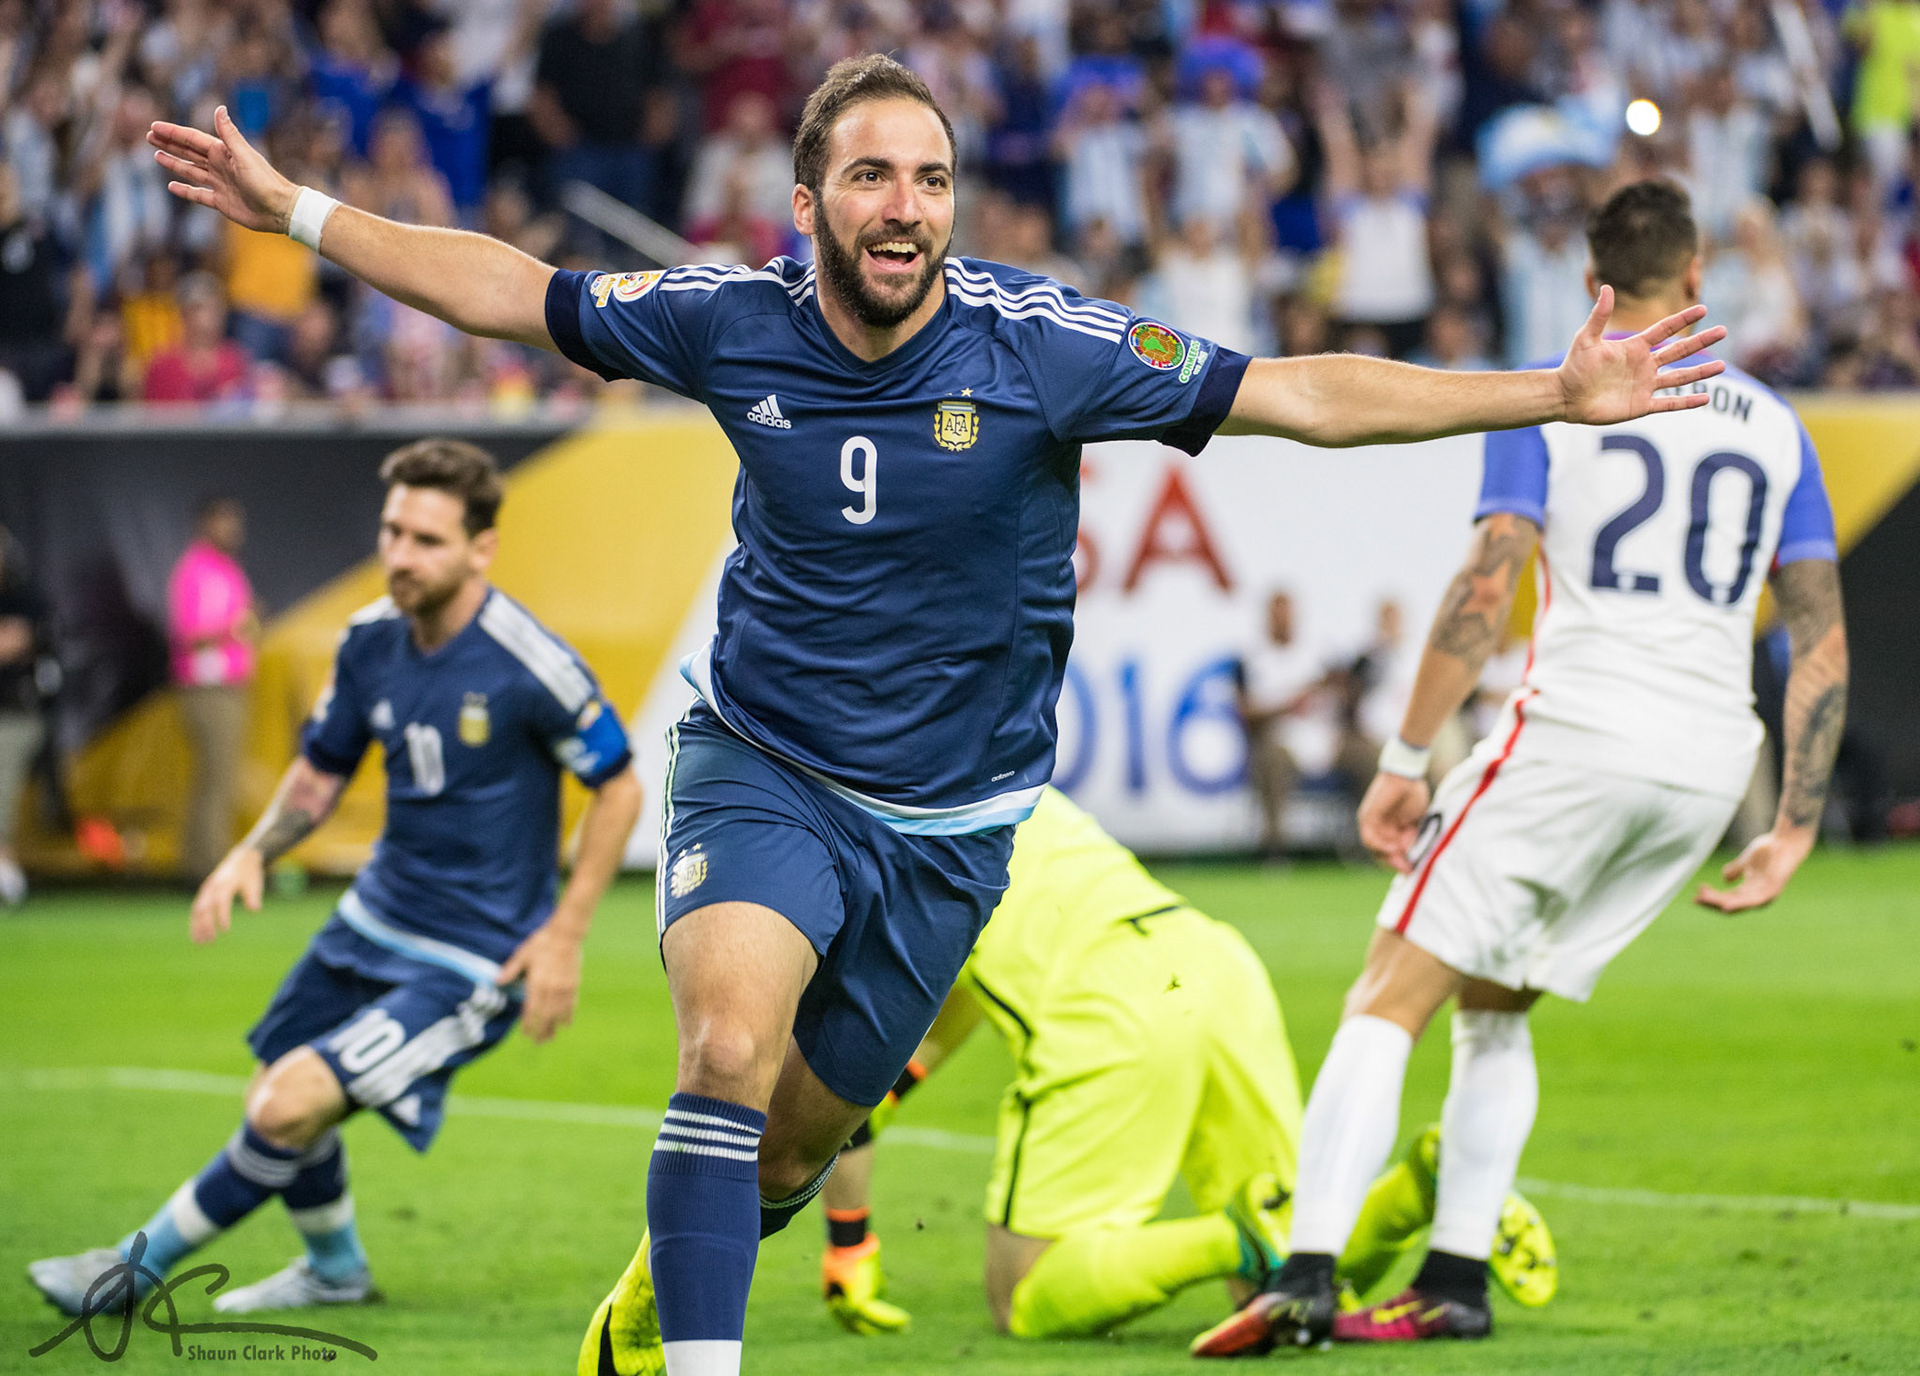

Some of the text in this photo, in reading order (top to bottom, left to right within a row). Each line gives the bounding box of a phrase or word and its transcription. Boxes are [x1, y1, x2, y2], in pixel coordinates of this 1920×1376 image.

[747, 411, 792, 430] adidas
[944, 412, 969, 436] AFA
[840, 436, 878, 525] 9
[1590, 433, 1768, 607] 20
